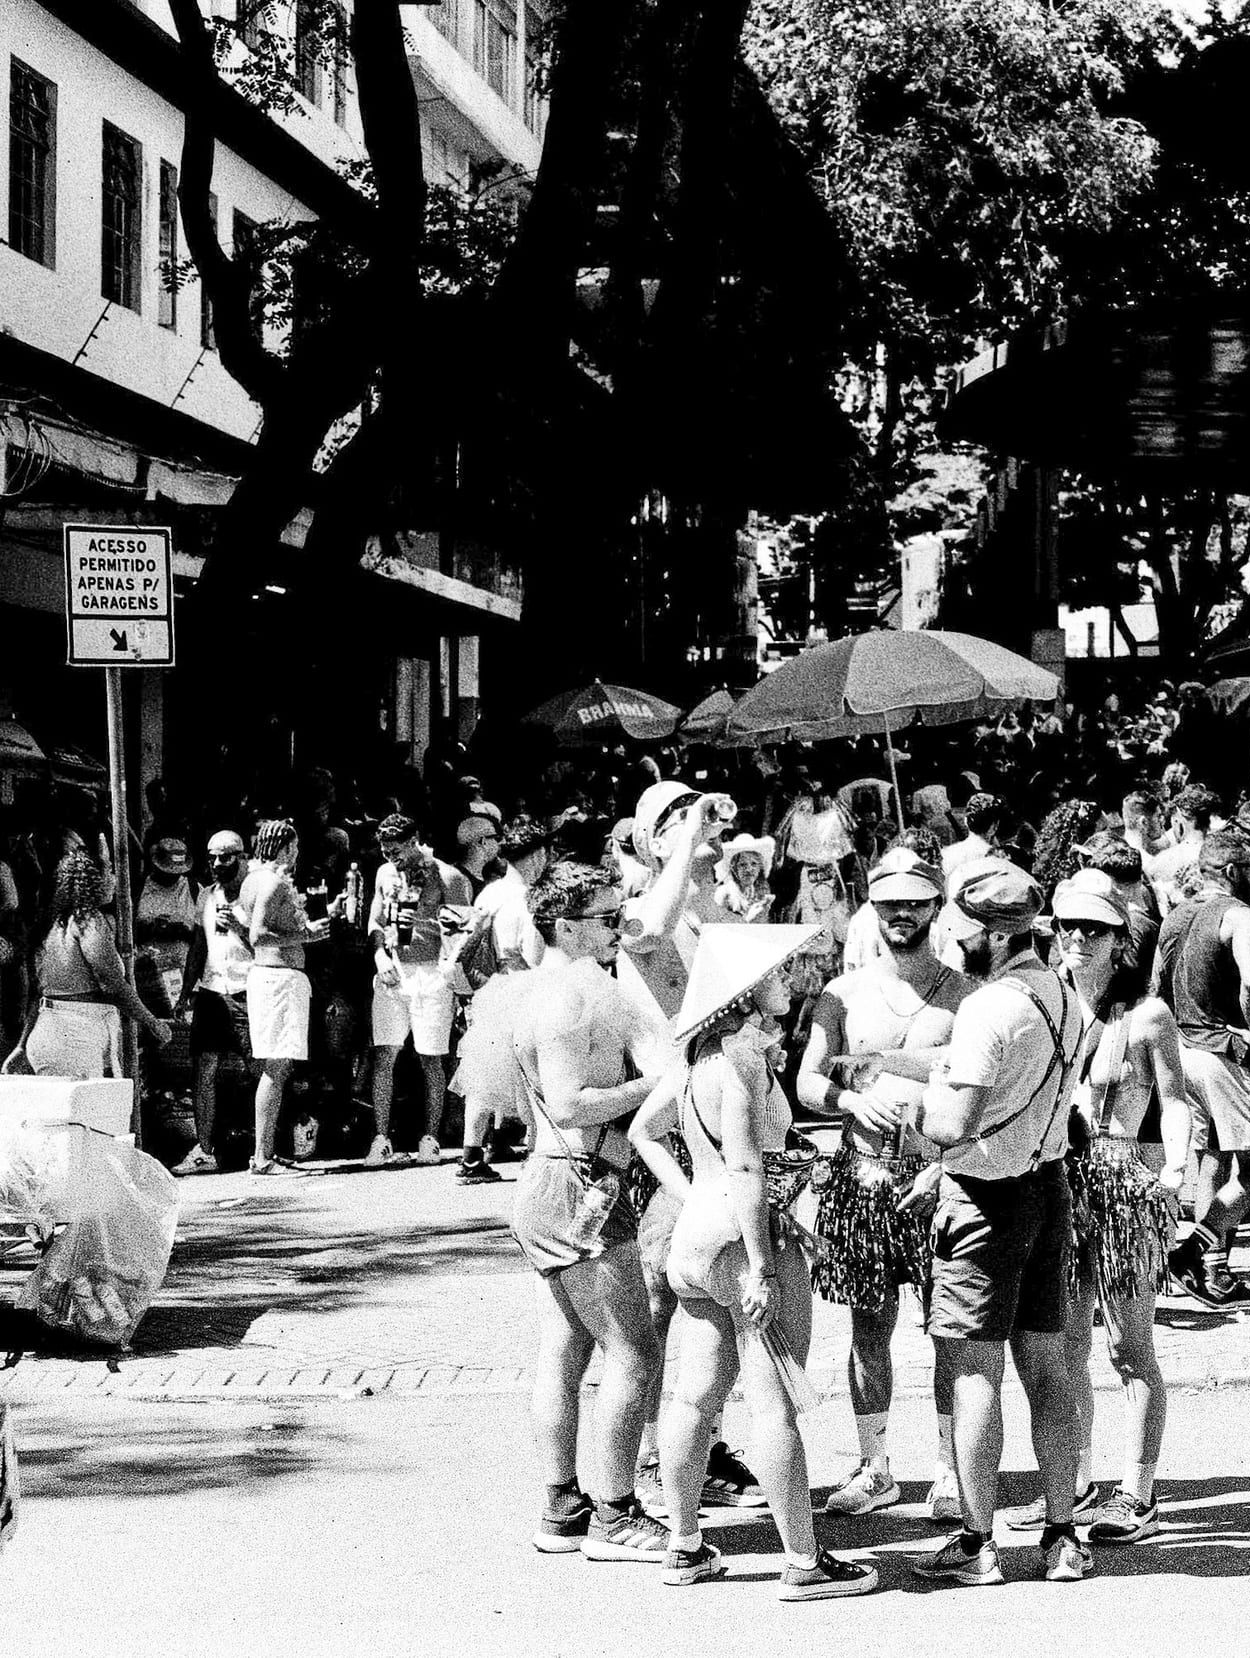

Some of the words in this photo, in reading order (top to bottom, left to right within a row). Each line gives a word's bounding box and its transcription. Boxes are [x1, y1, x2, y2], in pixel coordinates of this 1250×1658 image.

[88, 537, 147, 553] ACESSO
[79, 557, 156, 572] PERMITIDO
[78, 576, 135, 591] APENAS
[143, 578, 160, 591] P/
[81, 595, 159, 610] GARAGENS
